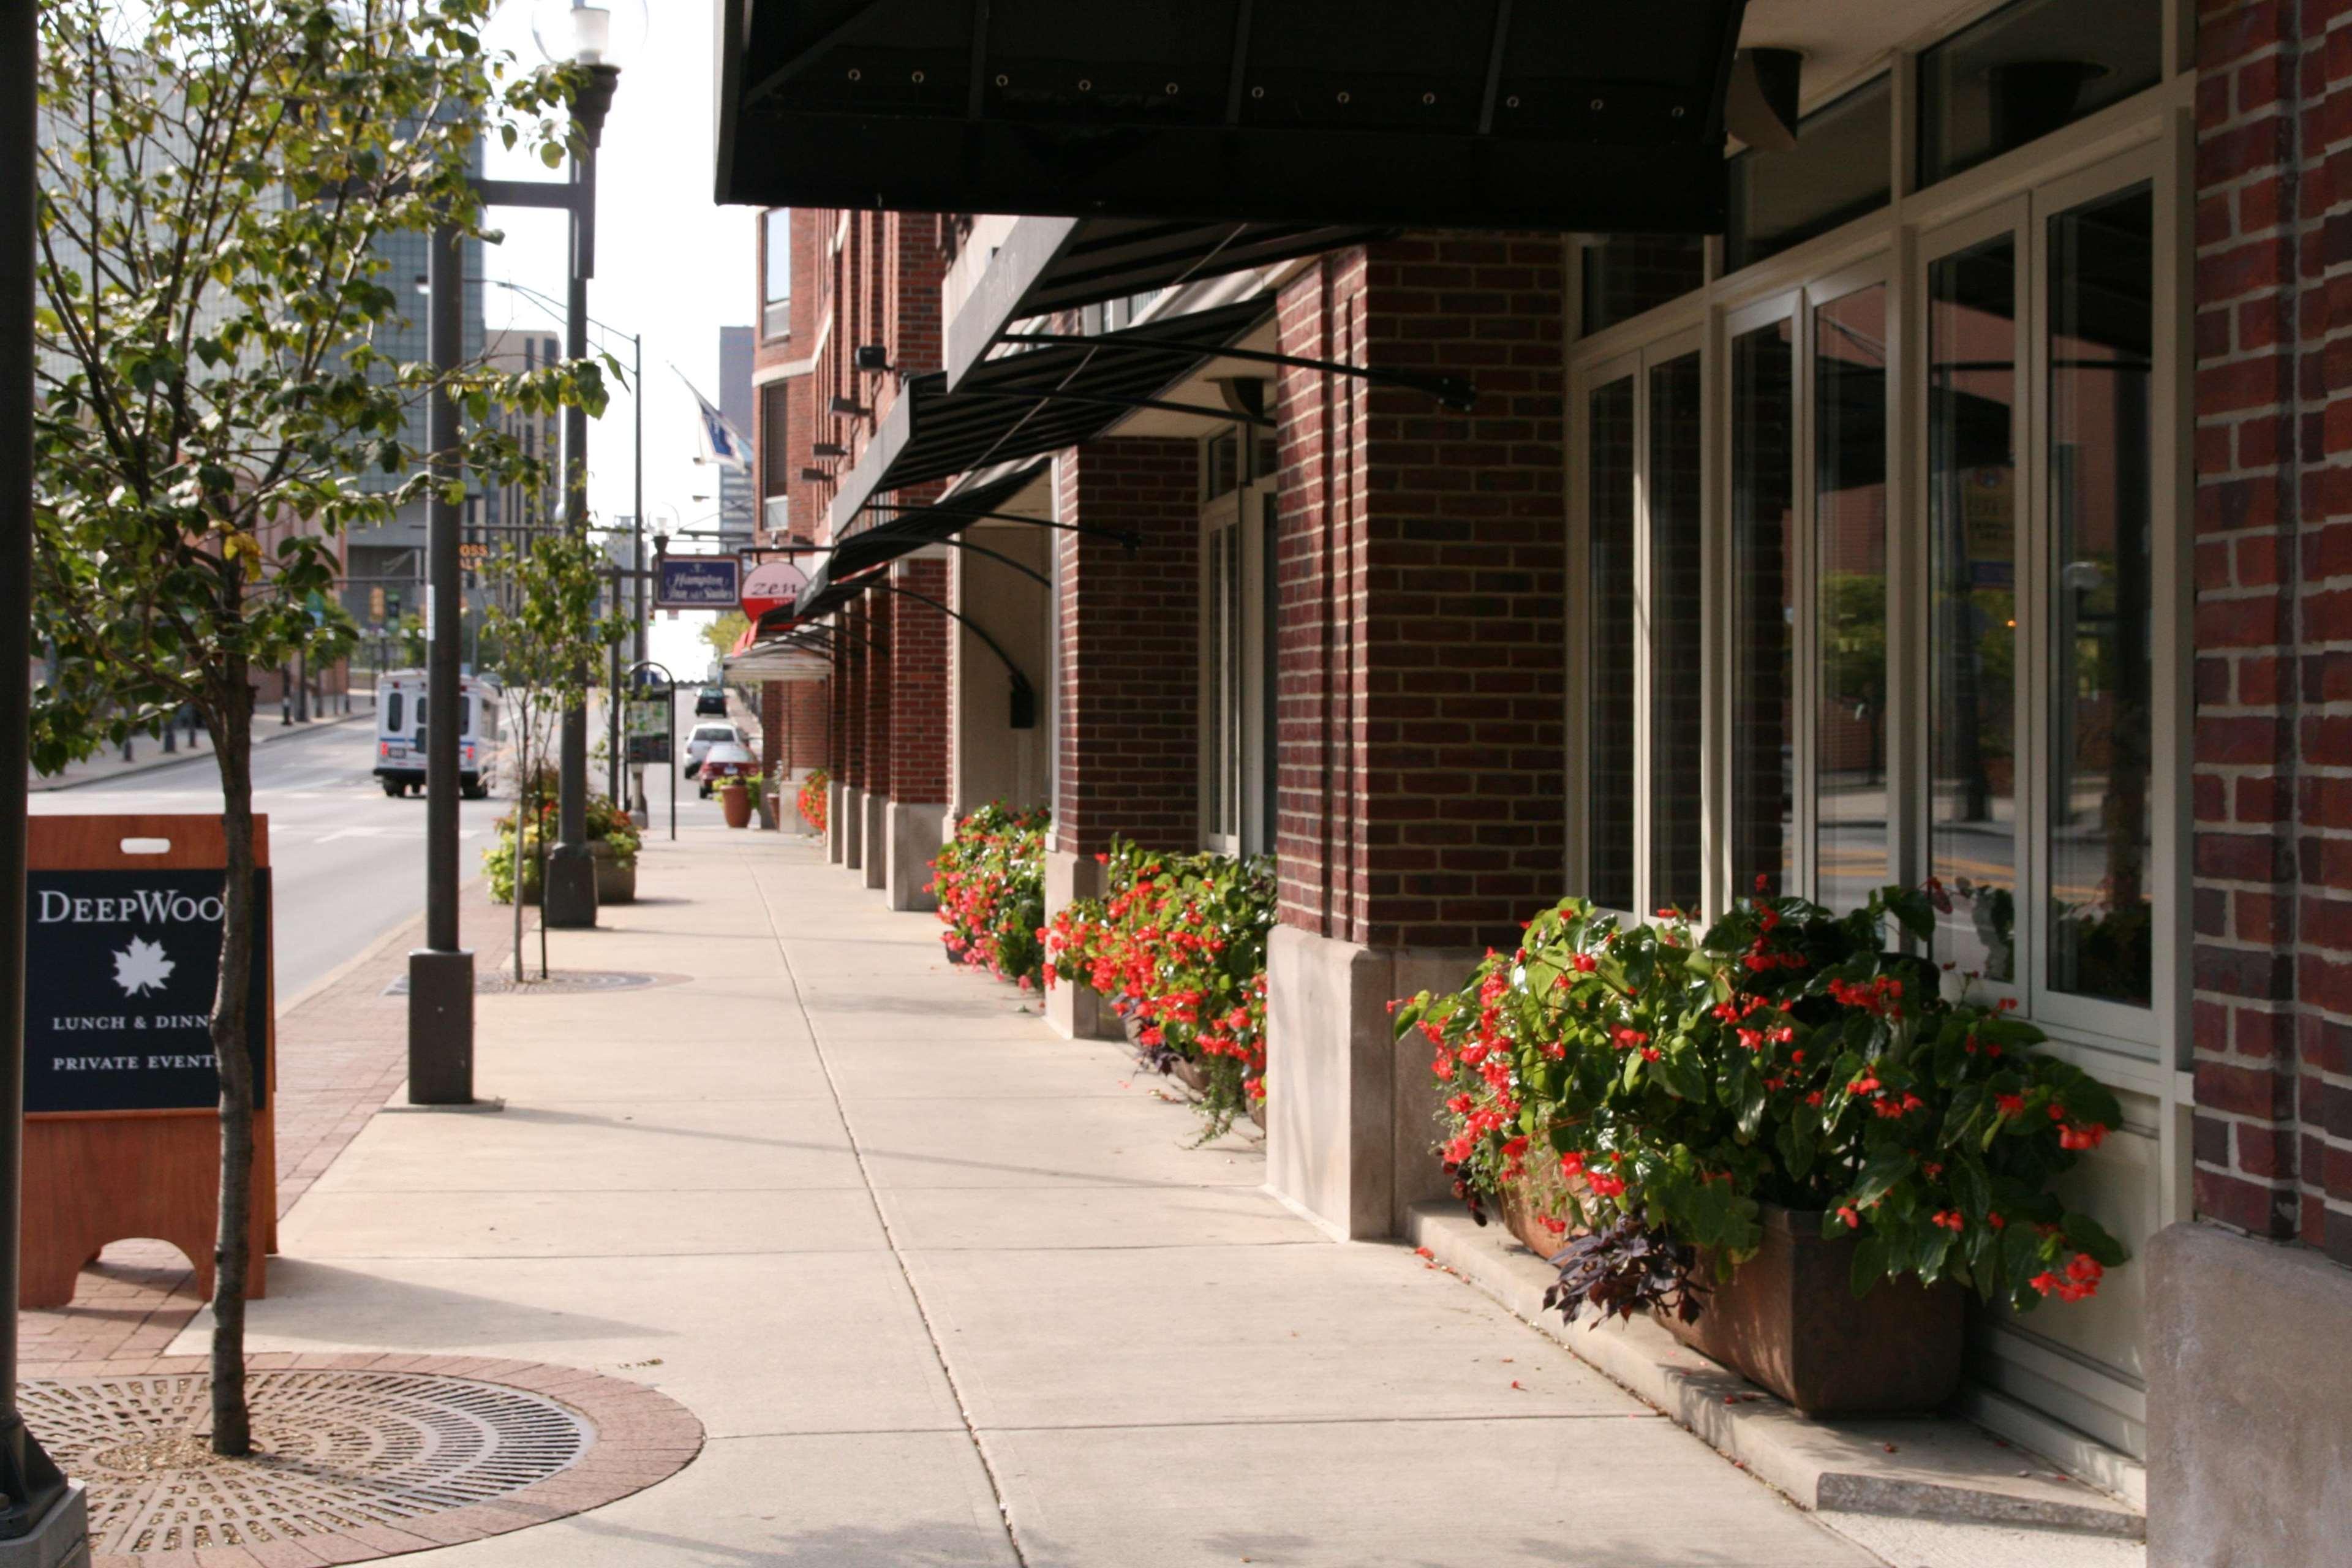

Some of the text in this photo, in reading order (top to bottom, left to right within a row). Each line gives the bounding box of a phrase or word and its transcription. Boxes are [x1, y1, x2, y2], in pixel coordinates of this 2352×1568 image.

[38, 890, 224, 924] DEEPWOO
[53, 1015, 208, 1030] LUNCH & DINN
[53, 1055, 217, 1071] PRIVATE EVENT
